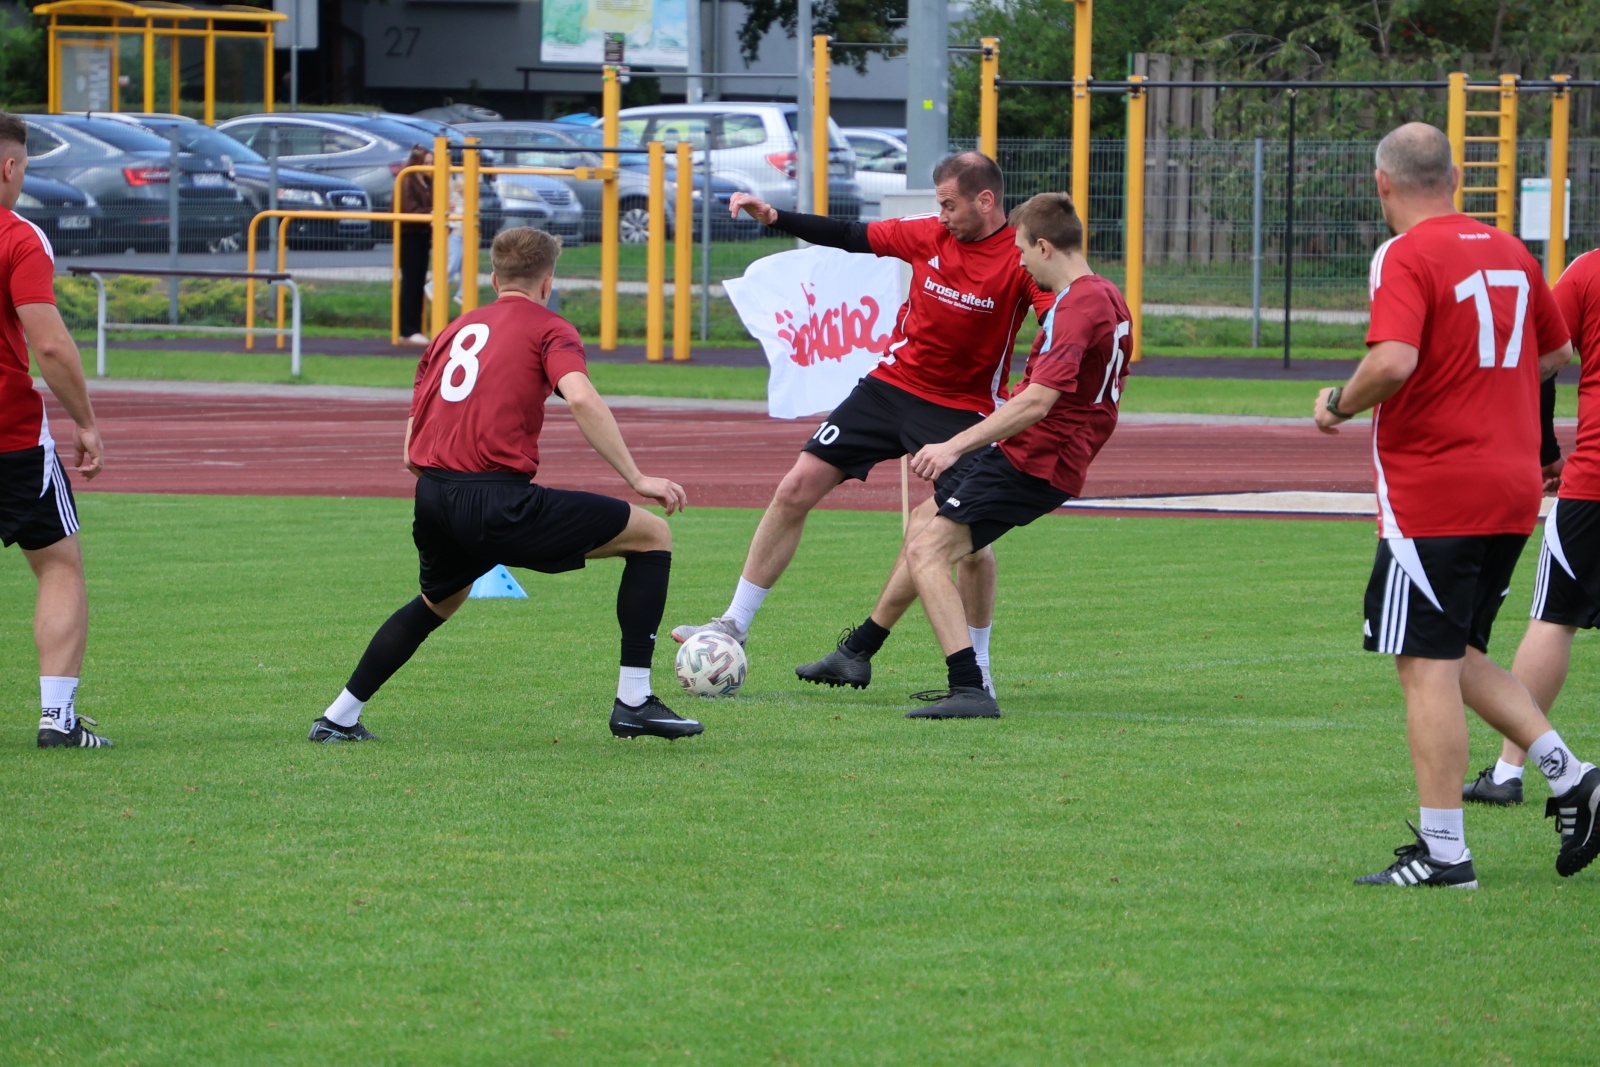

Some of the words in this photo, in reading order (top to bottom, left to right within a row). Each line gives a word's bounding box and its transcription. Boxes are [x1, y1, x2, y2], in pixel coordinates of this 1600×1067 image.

[384, 26, 421, 57] 27
[924, 276, 960, 300] brose
[960, 292, 995, 309] sitech
[1454, 269, 1530, 368] 17
[440, 323, 490, 402] 8
[812, 421, 840, 446] 10
